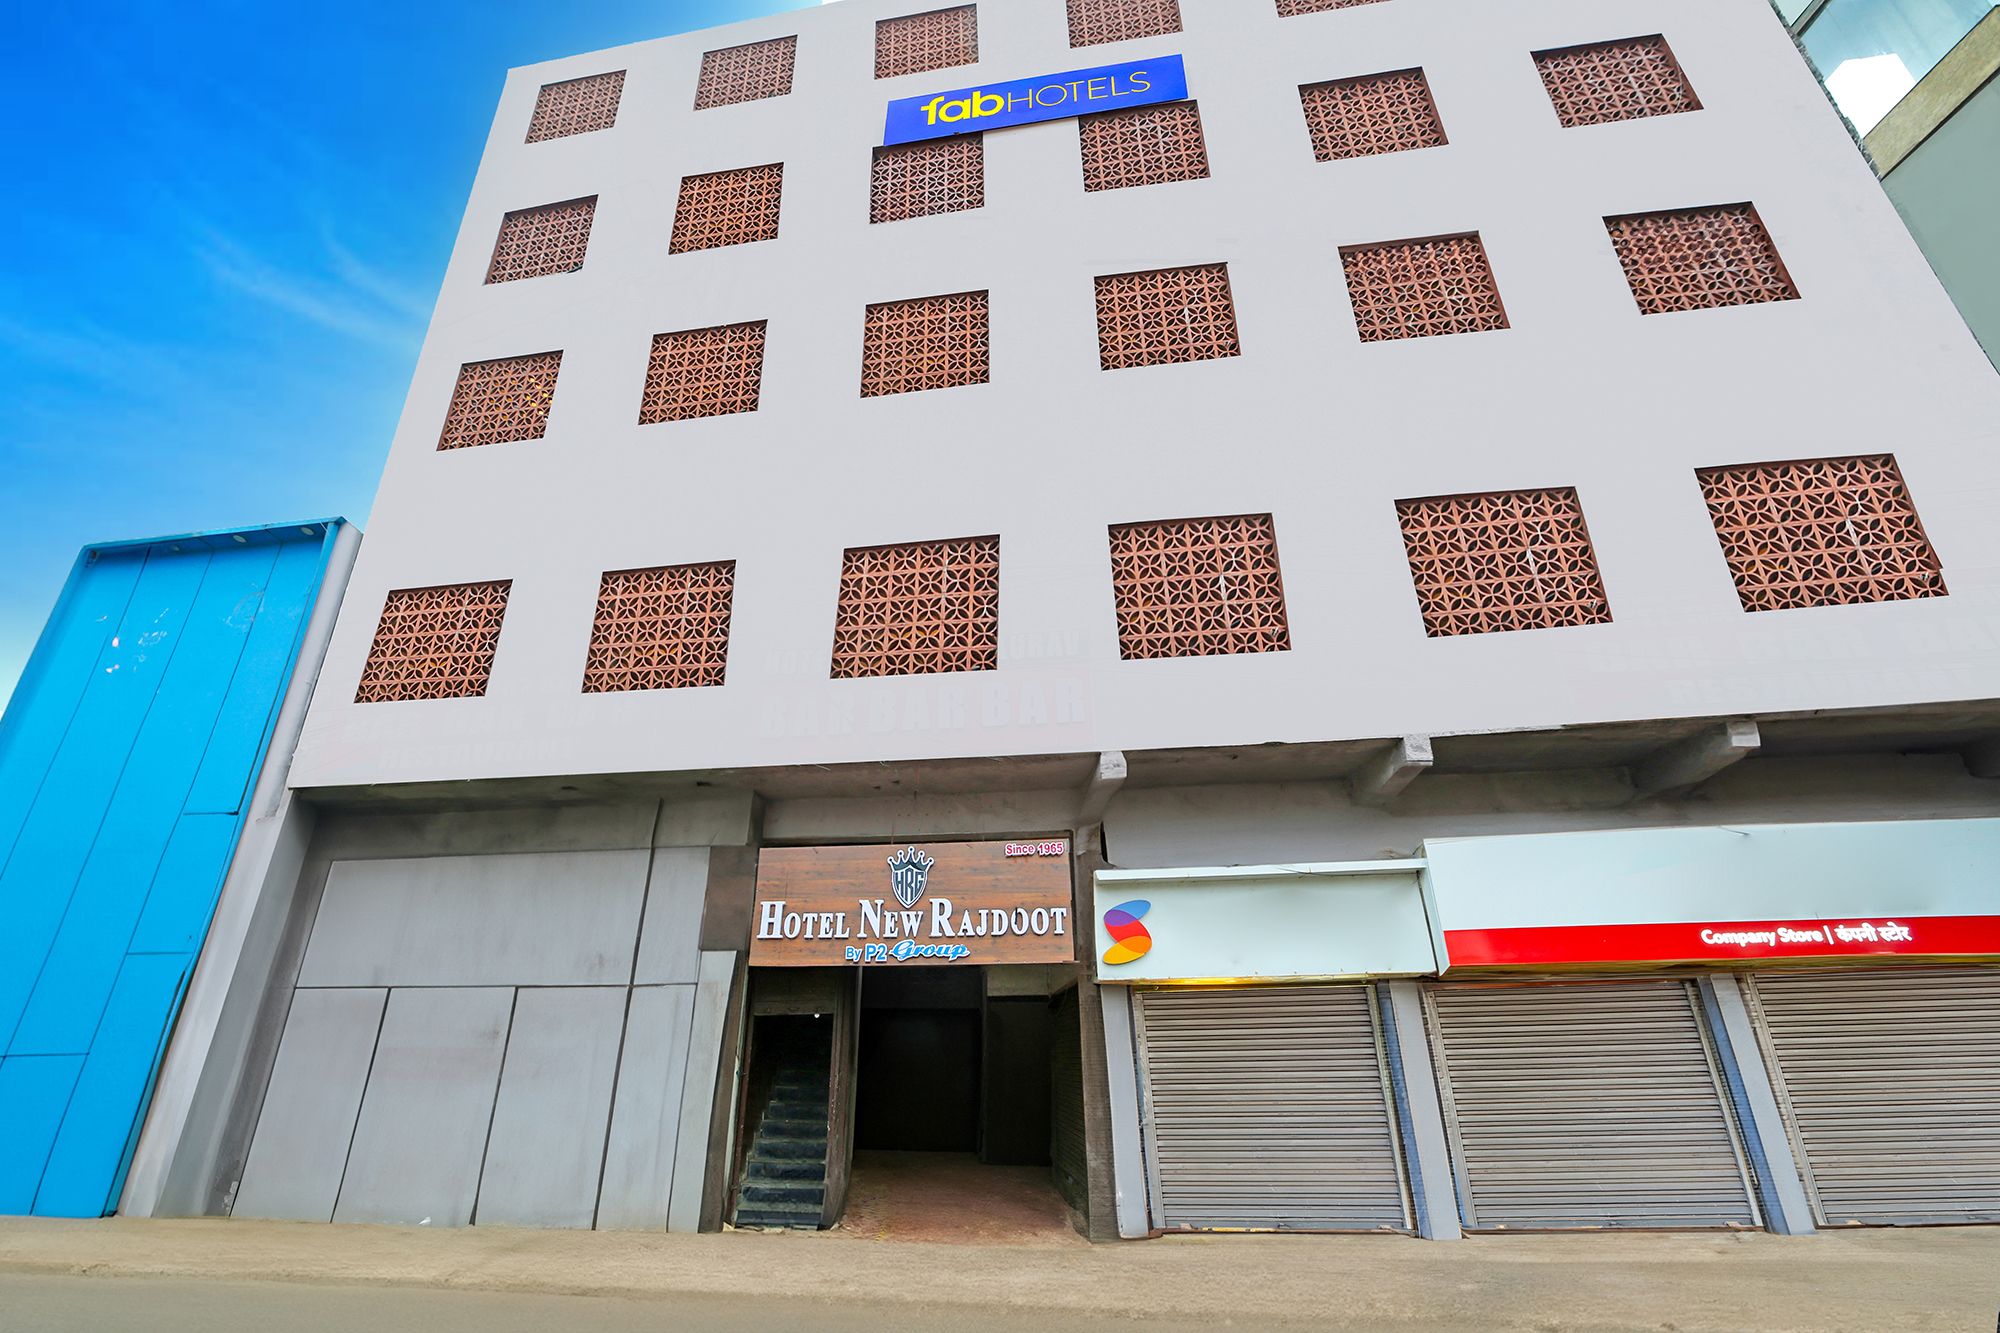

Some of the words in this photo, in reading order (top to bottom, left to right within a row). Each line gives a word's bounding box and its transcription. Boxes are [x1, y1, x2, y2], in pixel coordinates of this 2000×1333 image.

[920, 71, 1151, 125] fabHOTELS
[1005, 843, 1035, 857] Since
[1037, 842, 1064, 856] 1965
[757, 901, 850, 939] HOTEL
[857, 899, 924, 939] NEW
[929, 898, 1067, 938] RAJDOOT
[1700, 929, 1776, 947] Company
[1777, 927, 1824, 943] Store
[1835, 924, 1878, 942] कंपनी
[1878, 921, 1912, 941] स्टोर
[845, 945, 862, 963] By
[864, 943, 888, 963] P2
[889, 939, 970, 961] Group
